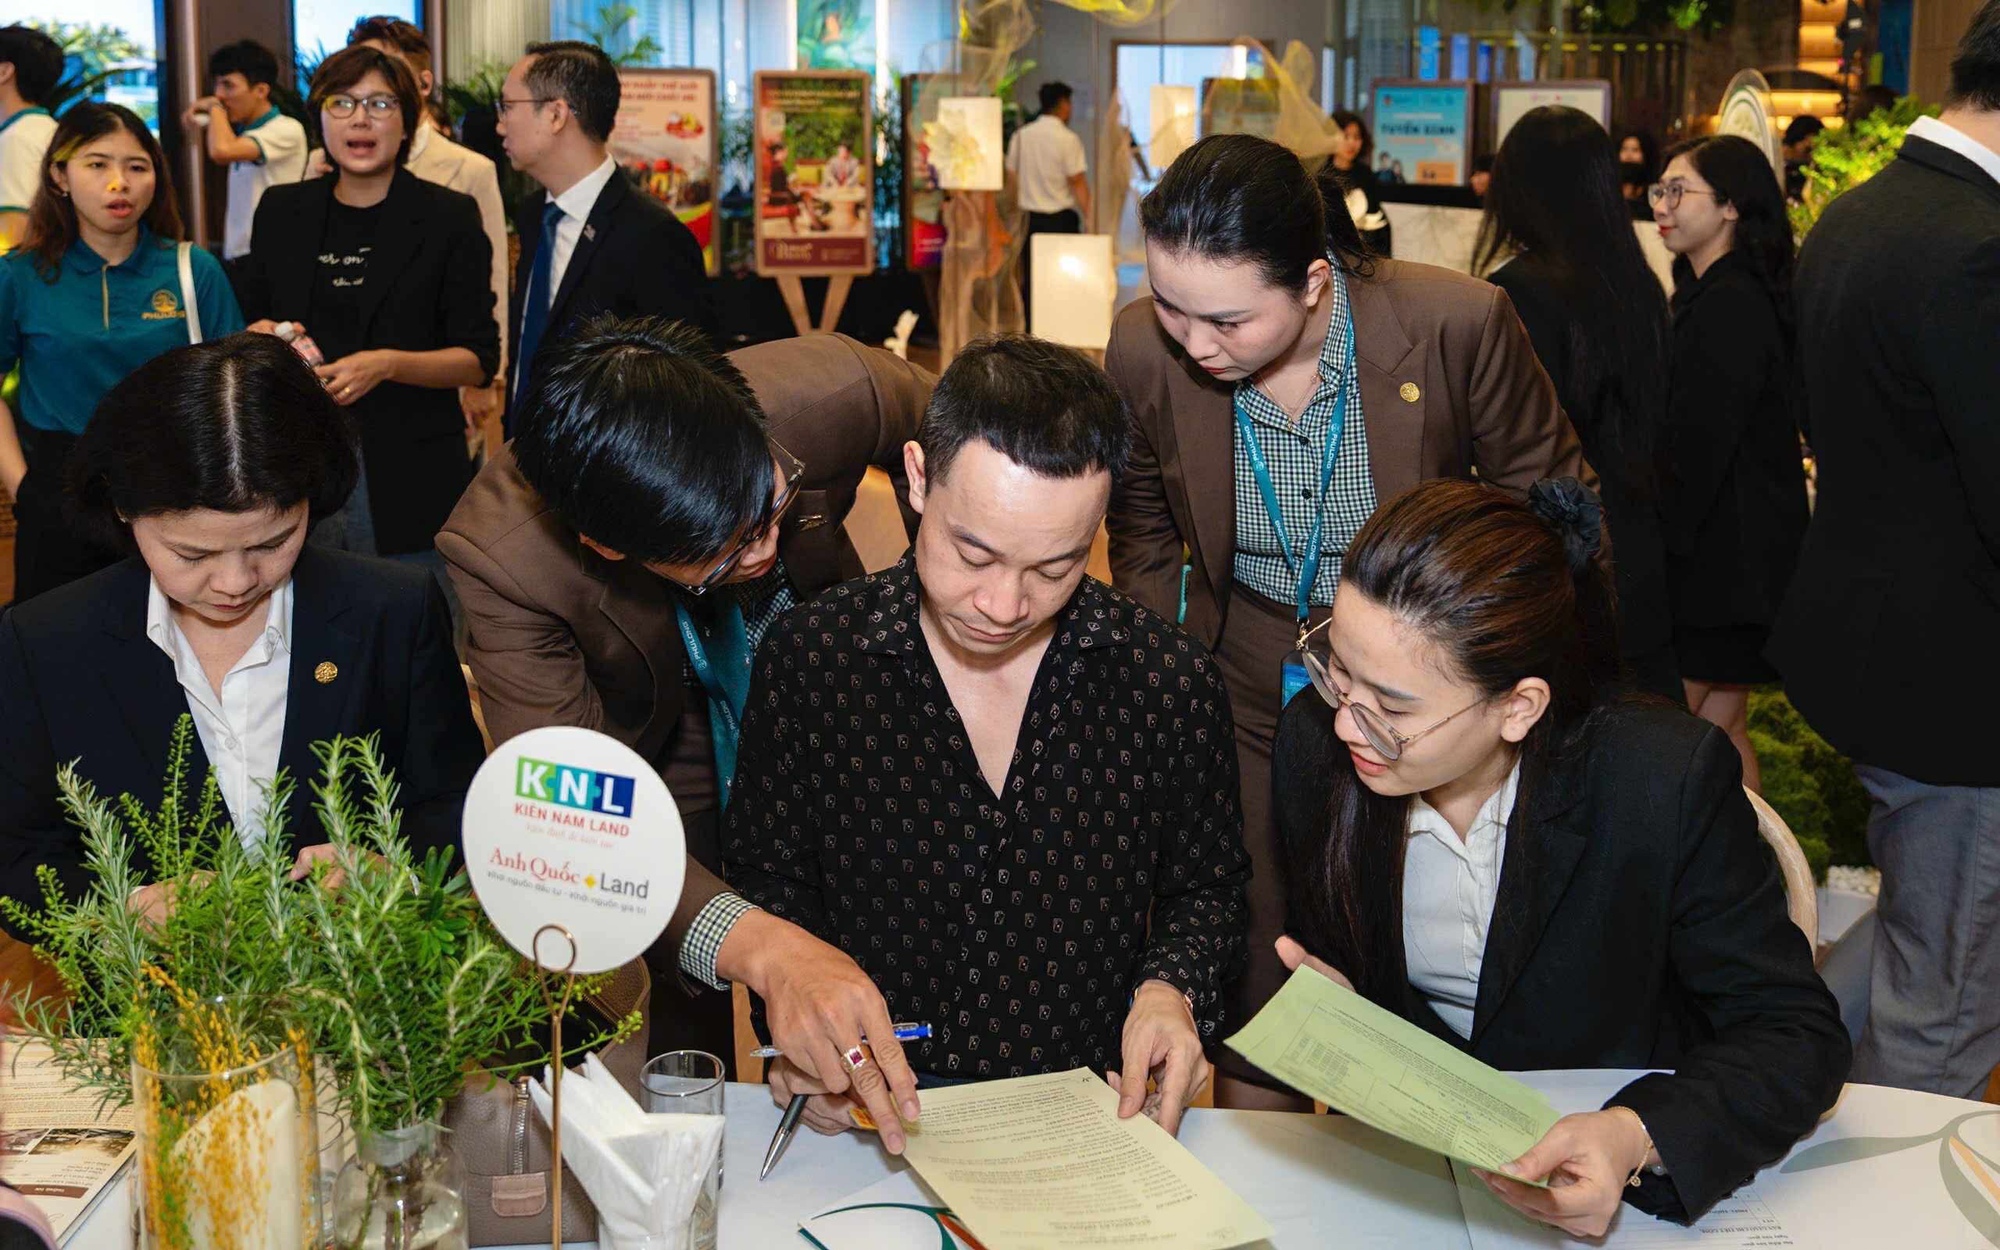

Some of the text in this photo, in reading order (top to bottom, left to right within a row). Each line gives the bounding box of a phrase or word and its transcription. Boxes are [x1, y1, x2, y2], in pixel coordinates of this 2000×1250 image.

[1244, 425, 1259, 461] PHULONG
[1326, 433, 1338, 469] PHULONG
[682, 620, 701, 660] PHULONG
[521, 762, 625, 814] KNL
[552, 811, 586, 829] NAM
[590, 819, 630, 836] LAND
[600, 871, 649, 899] Land
